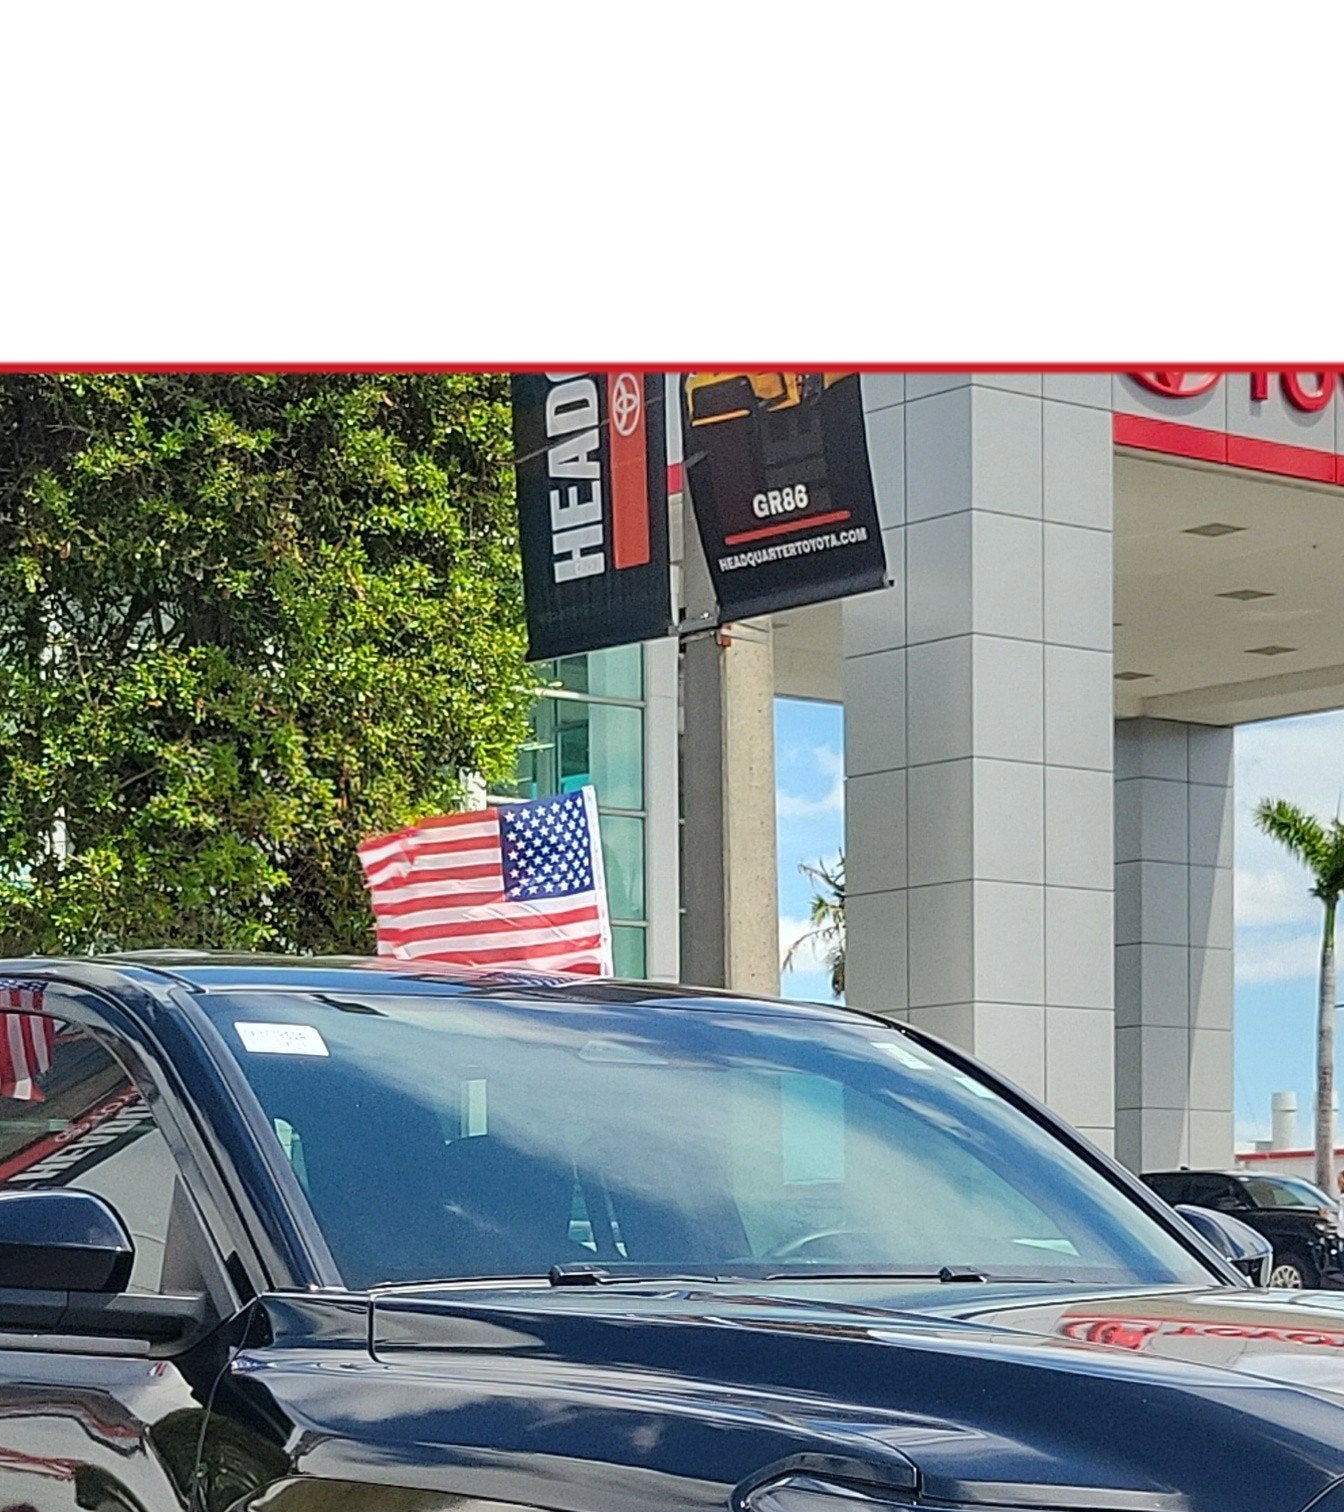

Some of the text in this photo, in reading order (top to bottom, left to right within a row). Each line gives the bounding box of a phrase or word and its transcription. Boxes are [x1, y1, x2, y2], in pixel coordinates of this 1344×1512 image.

[545, 373, 606, 584] HEAD
[752, 484, 809, 518] GR86
[718, 526, 868, 573] HEADQUARTERTOYOTA.COM
